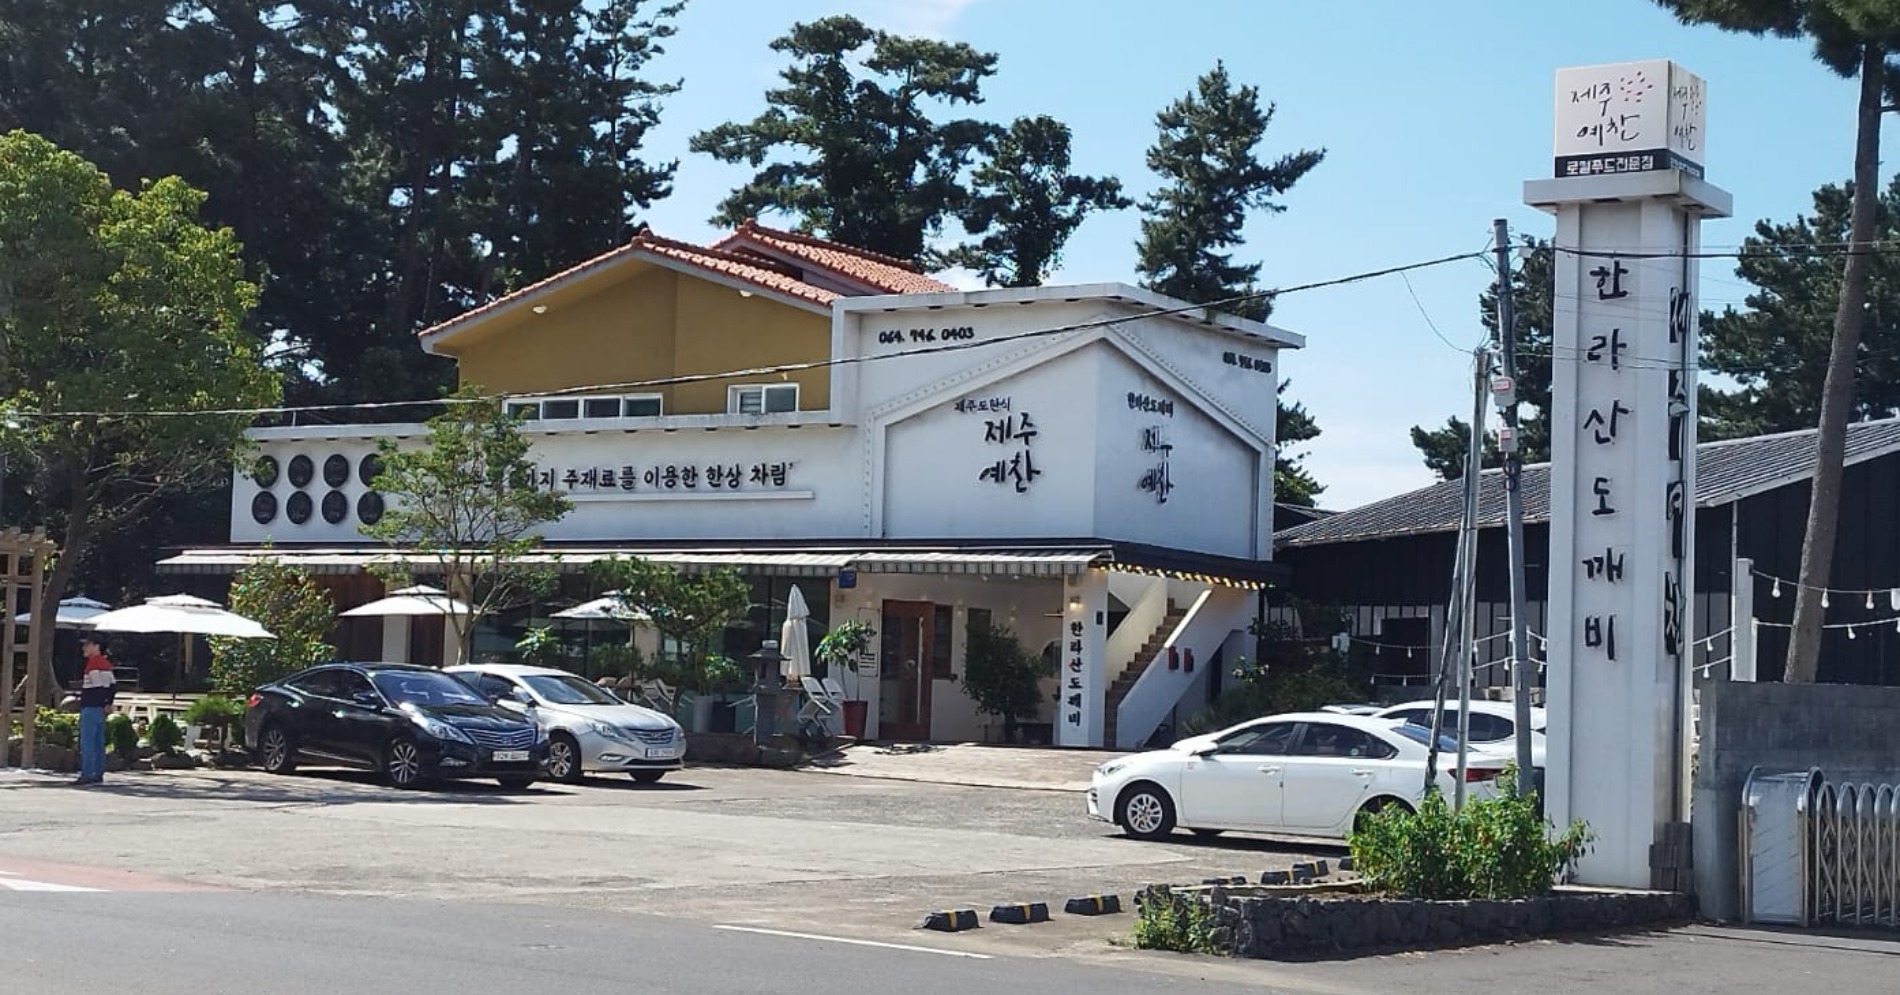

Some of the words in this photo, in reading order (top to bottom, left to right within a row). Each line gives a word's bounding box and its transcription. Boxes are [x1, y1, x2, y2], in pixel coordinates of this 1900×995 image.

[1571, 82, 1611, 117] 제주
[1577, 114, 1640, 146] 예찬
[941, 327, 974, 341] 0403
[984, 412, 1037, 445] 제주
[562, 466, 636, 491] 주재료를
[644, 465, 698, 489] 이용한
[706, 463, 742, 489] 한상
[979, 449, 1041, 493] 예찬
[1582, 260, 1632, 661] 한라산도깨비
